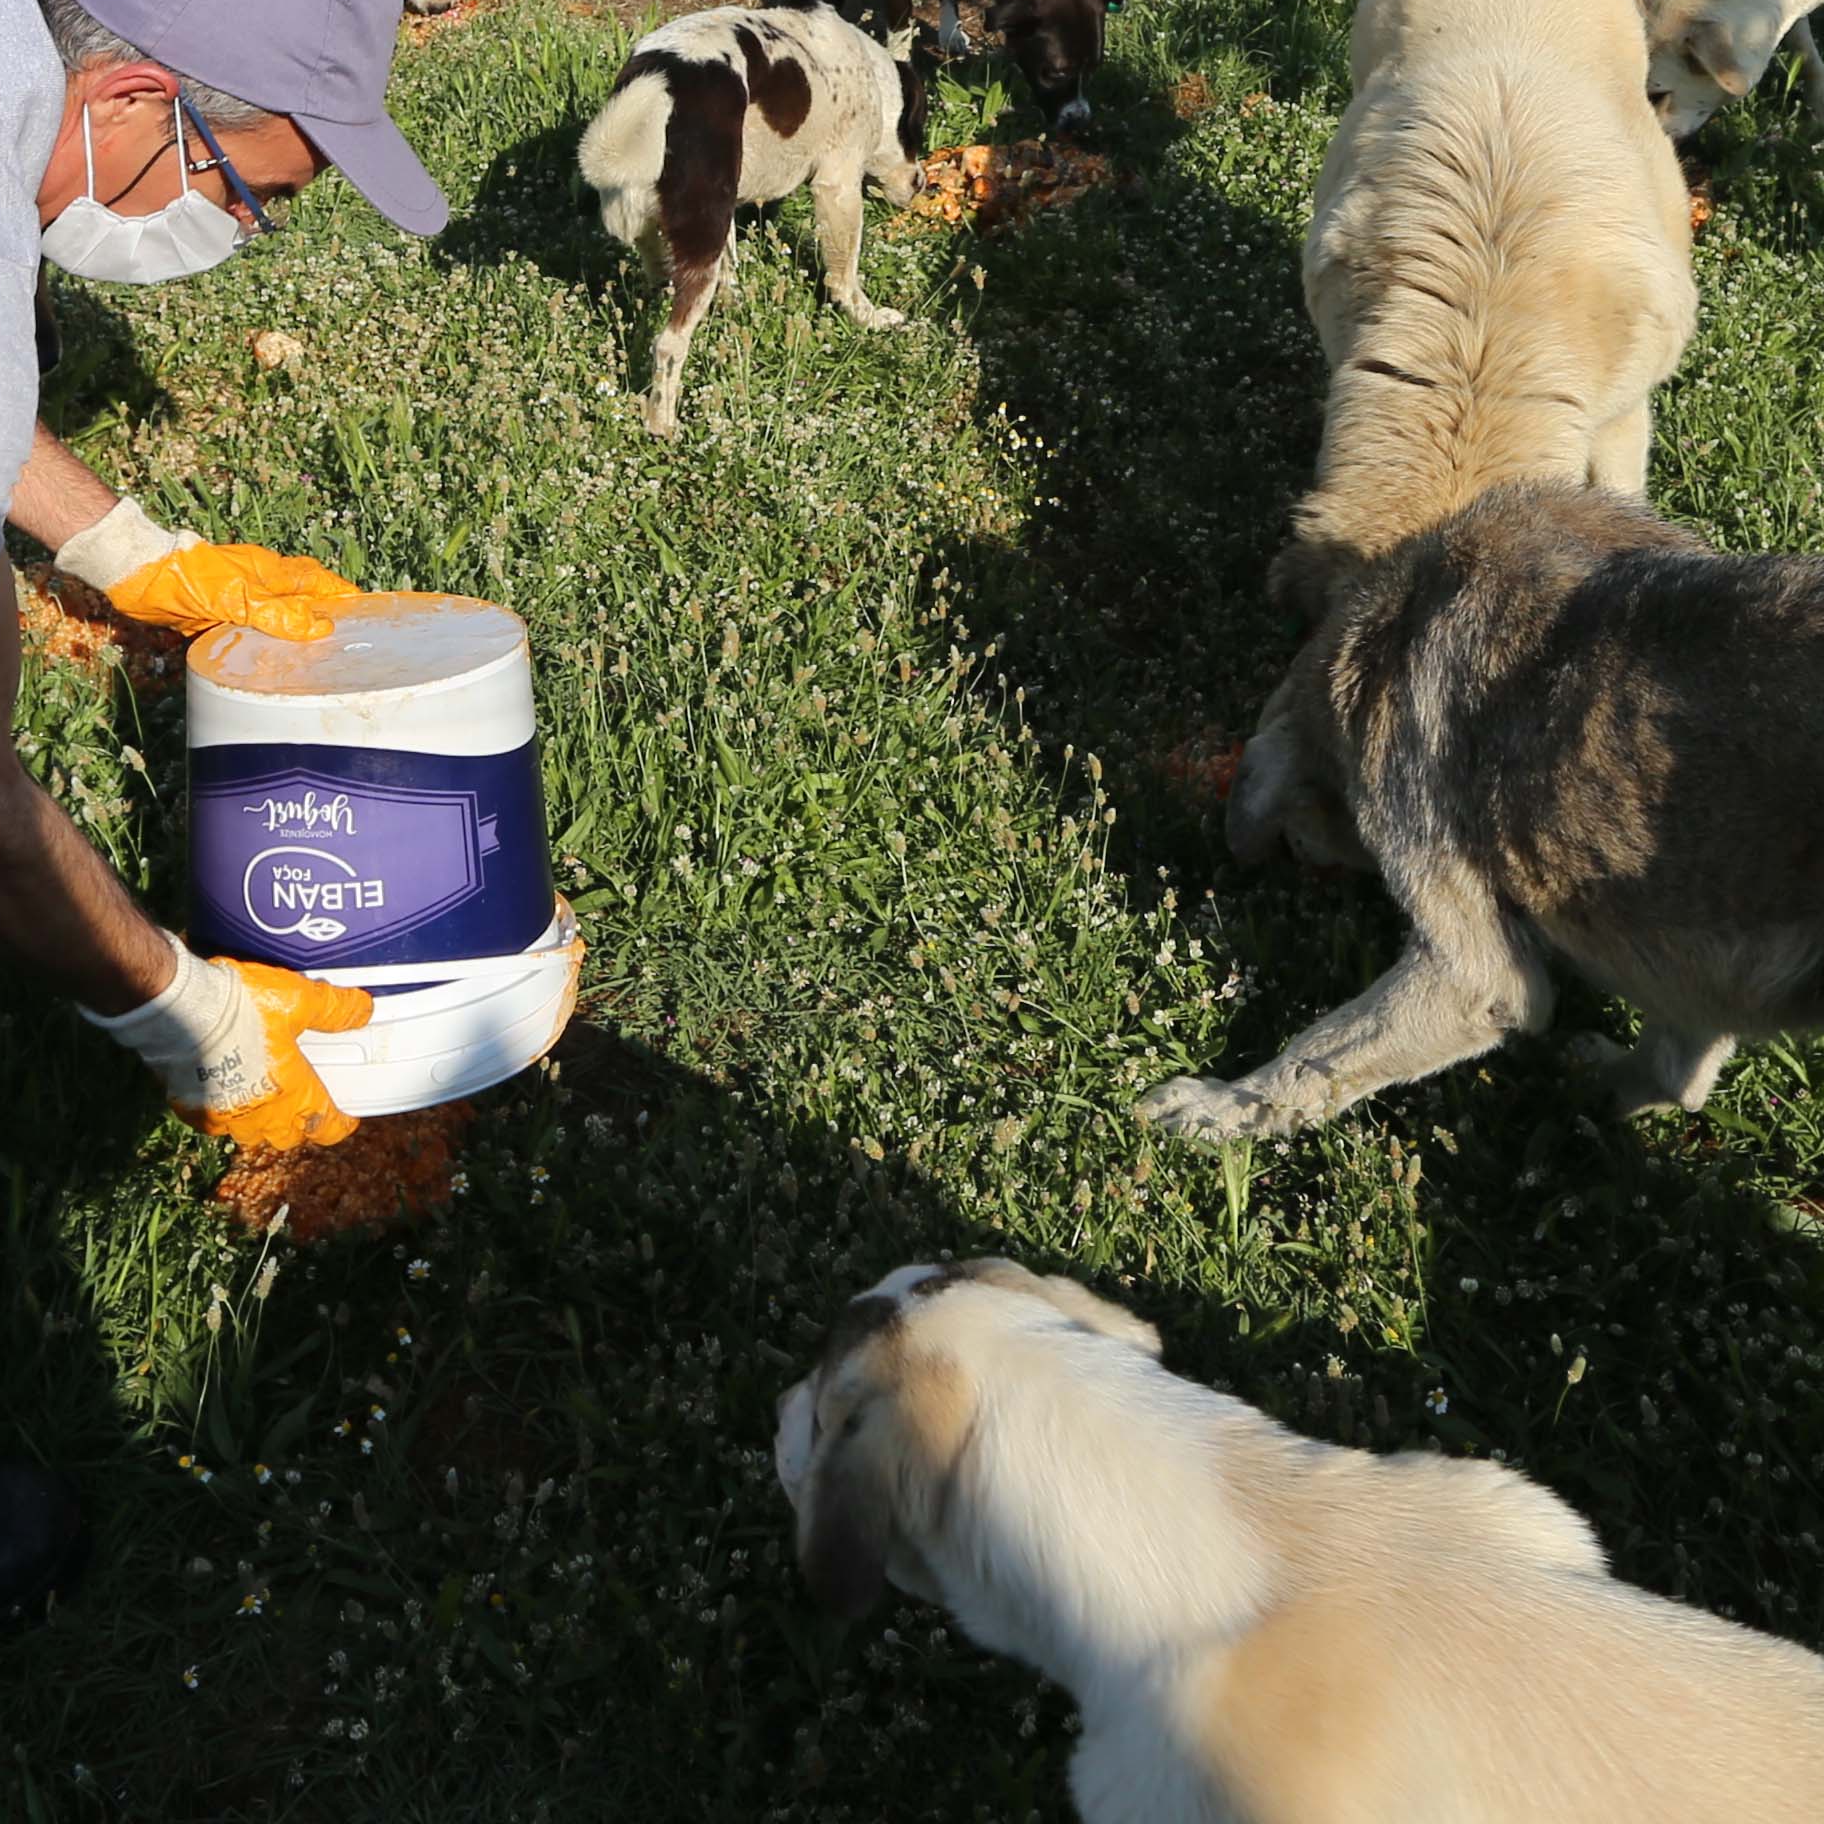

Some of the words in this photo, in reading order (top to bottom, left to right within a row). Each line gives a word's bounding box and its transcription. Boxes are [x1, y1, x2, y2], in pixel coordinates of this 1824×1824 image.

[272, 864, 312, 881] FOÇA
[272, 879, 385, 910] ELBAN
[196, 1048, 243, 1082] Beybi
